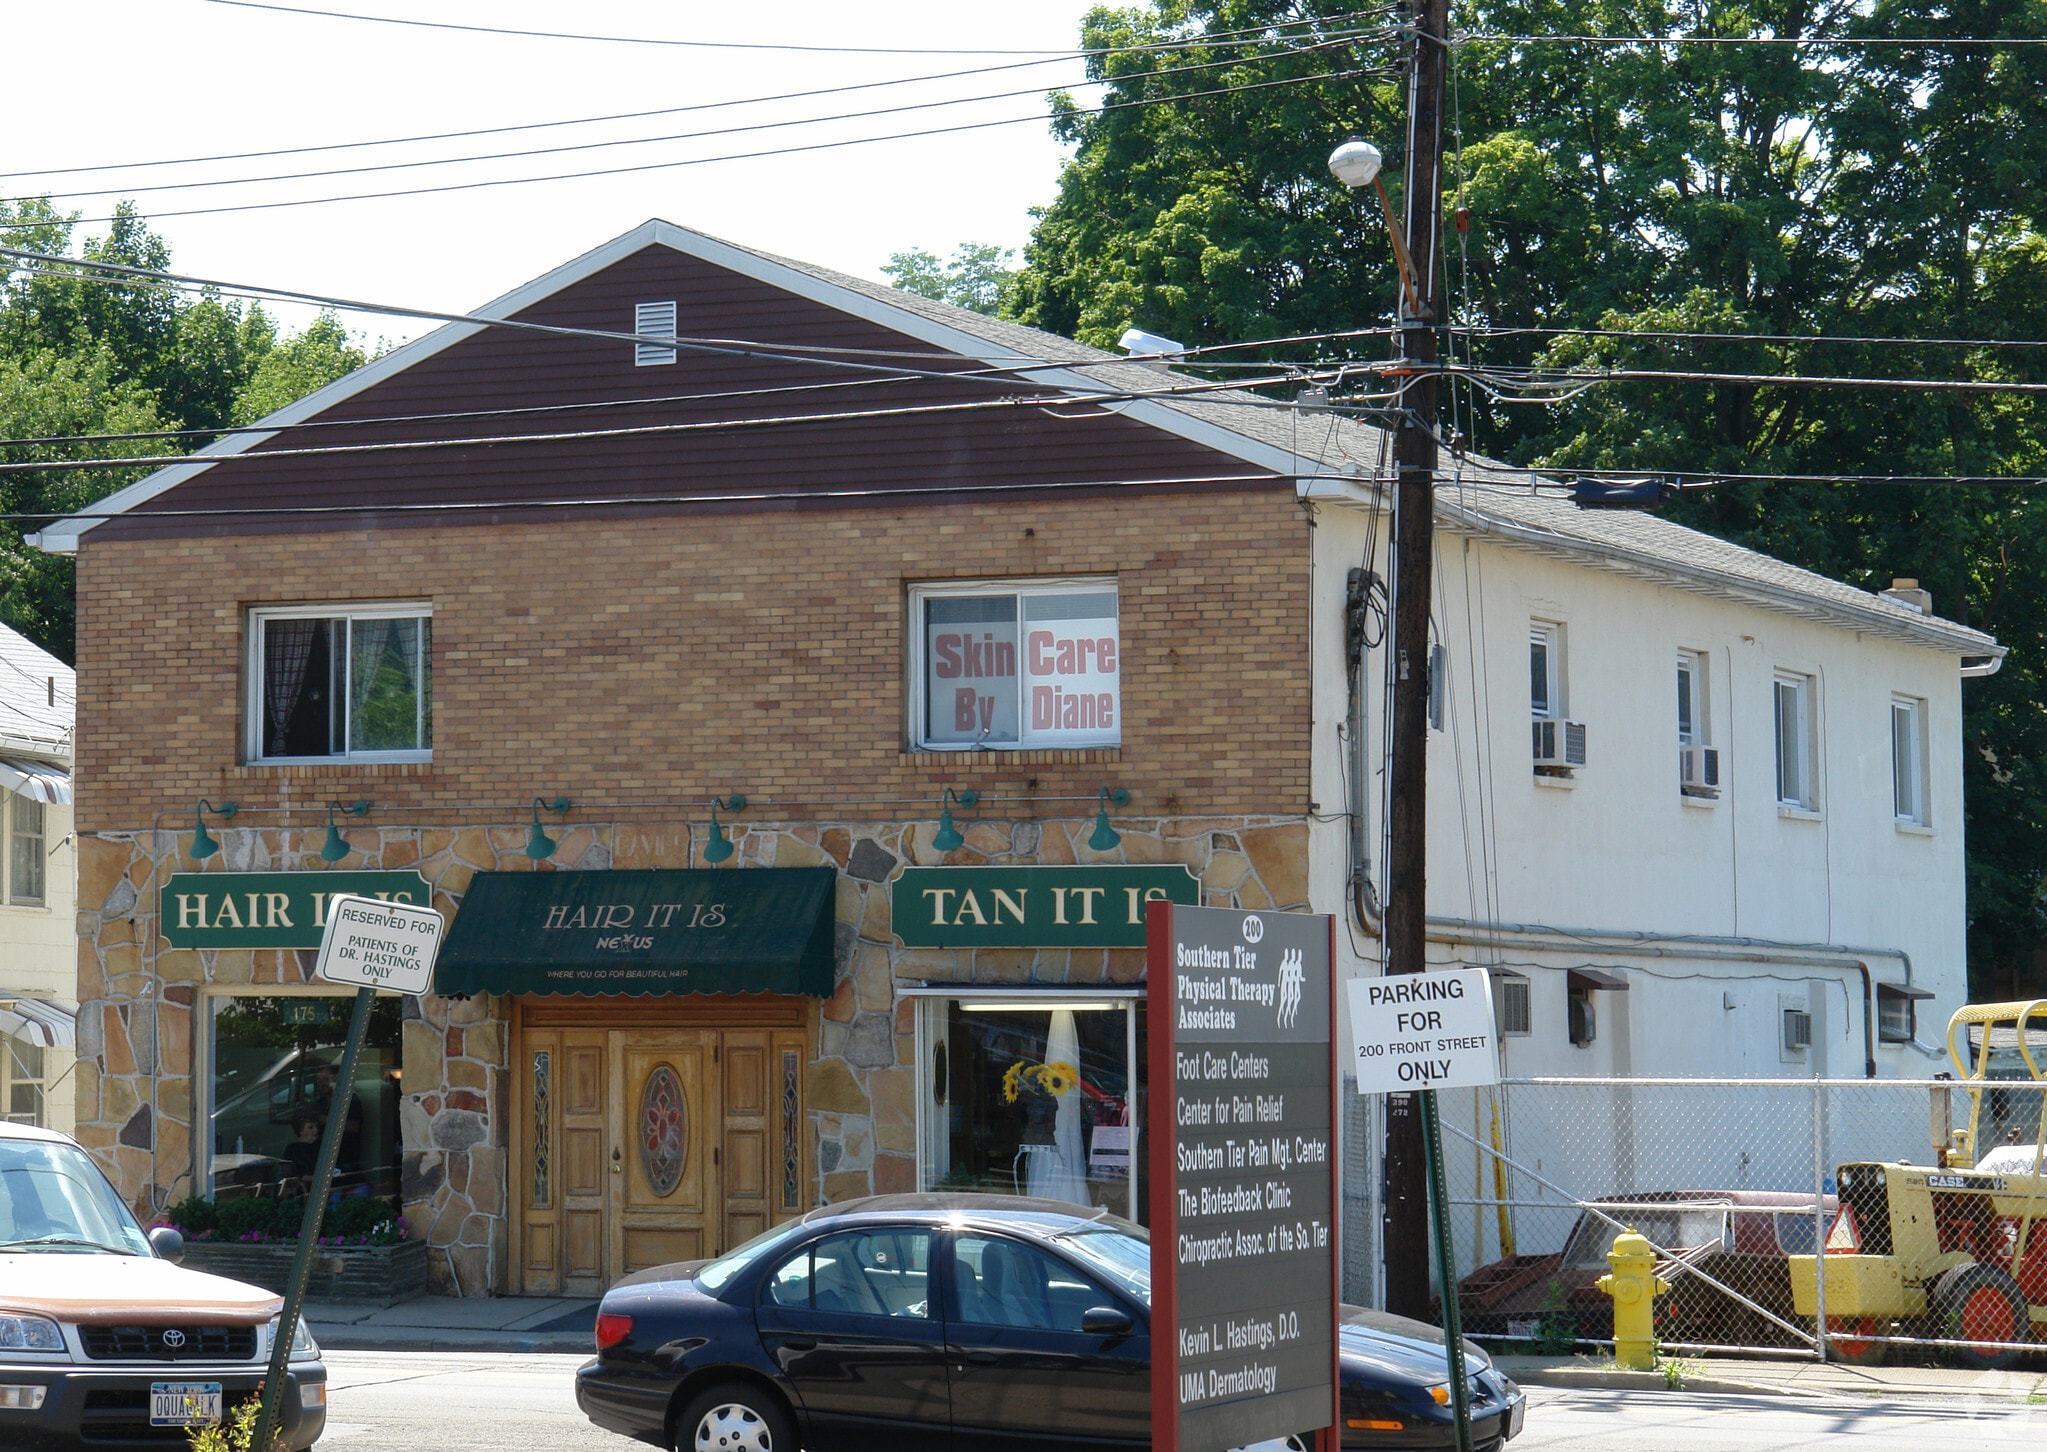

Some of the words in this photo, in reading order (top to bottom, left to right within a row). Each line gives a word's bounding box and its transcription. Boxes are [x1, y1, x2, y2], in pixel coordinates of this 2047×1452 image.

[935, 632, 1015, 679] Skin
[1028, 630, 1116, 676] Care
[955, 687, 995, 732] By
[1032, 684, 1114, 730] Diane
[175, 892, 294, 929] HAIR
[311, 892, 360, 928] I
[542, 904, 634, 929] HAIR
[644, 903, 681, 928] IT
[686, 902, 727, 929] IS
[922, 888, 1029, 925] TAN
[1050, 887, 1105, 925] IT
[342, 908, 406, 930] RESERVED
[410, 921, 436, 935] FOR
[1245, 920, 1261, 938] 200
[339, 947, 358, 961] DR.
[363, 952, 421, 971] HASTINGS
[348, 935, 398, 954] PATIENTS
[402, 944, 418, 957] OF
[1177, 942, 1230, 969] Southern
[1234, 945, 1256, 969] Tier
[362, 964, 392, 979] ONLY
[547, 970, 574, 978] WHERE
[576, 970, 593, 978] YOU
[594, 970, 607, 978] GO
[608, 970, 624, 978] FOR
[625, 970, 668, 978] BEAUTIFUL
[1178, 975, 1226, 1005] Physical
[1230, 976, 1275, 1006] Therapy
[1368, 978, 1464, 1005] PARKING
[1178, 1005, 1236, 1030] Associates
[1397, 1010, 1442, 1033] FOR
[1358, 1045, 1384, 1057] 200
[1389, 1040, 1431, 1055] FRONT
[1437, 1036, 1487, 1051] STREET
[1177, 1052, 1200, 1080] Foot
[1204, 1051, 1227, 1080] Care
[1231, 1052, 1269, 1079] Centers
[1397, 1059, 1452, 1081] ONLY
[1177, 1097, 1211, 1126] Center
[1215, 1097, 1229, 1124] for
[1233, 1096, 1253, 1123] Pain
[1257, 1094, 1284, 1122] Relief
[1177, 1141, 1223, 1172] Southern
[1226, 1140, 1246, 1168] Tier
[1249, 1140, 1269, 1167] Pain
[1272, 1138, 1292, 1171] Mgt.
[1296, 1137, 1327, 1163] Center
[1929, 1175, 1965, 1187] CASE
[1178, 1189, 1198, 1217] The
[1201, 1184, 1262, 1215] Biofeedback
[1266, 1182, 1291, 1209] Clinic
[1178, 1229, 1233, 1267] Chiropractic
[1235, 1228, 1265, 1256] Assoc.
[1268, 1226, 1277, 1251] of
[1279, 1225, 1293, 1250] the
[1296, 1222, 1310, 1249] So.
[1312, 1221, 1328, 1248] Tier
[1179, 1326, 1209, 1357] Kevin
[1213, 1324, 1223, 1350] L.
[1227, 1318, 1276, 1351] Hastings,
[1279, 1311, 1300, 1341] D.O.
[1180, 1373, 1205, 1404] UMA
[1209, 1362, 1277, 1397] Dermatology
